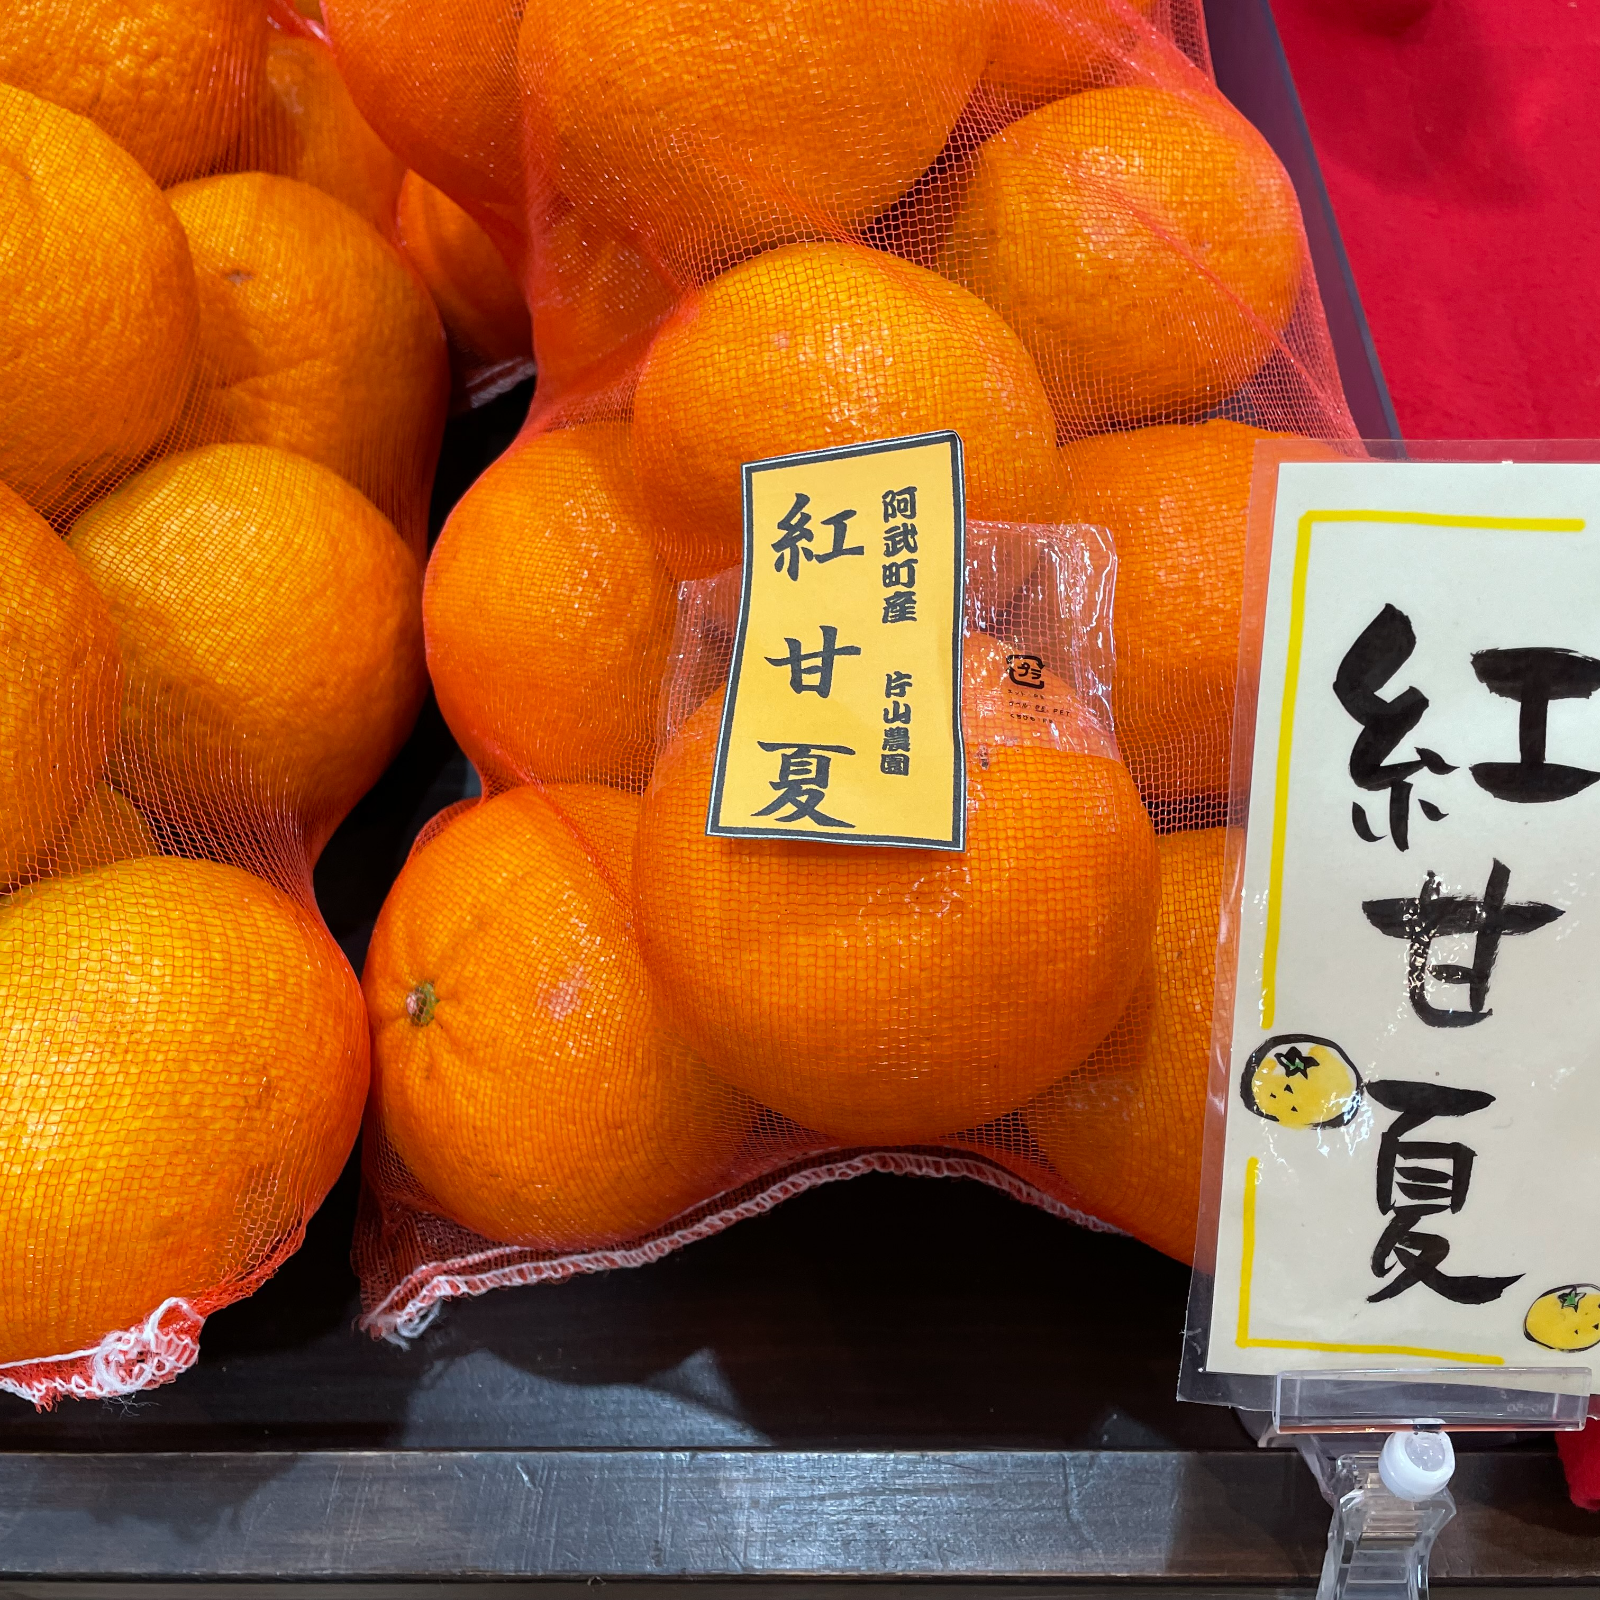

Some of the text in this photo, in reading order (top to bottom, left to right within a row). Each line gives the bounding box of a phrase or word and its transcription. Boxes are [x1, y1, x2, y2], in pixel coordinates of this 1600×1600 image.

[750, 493, 864, 829] 紅甘夏
[880, 486, 919, 776] 阿武町産 片山農園
[1333, 603, 1600, 1305] 紅甘夏
